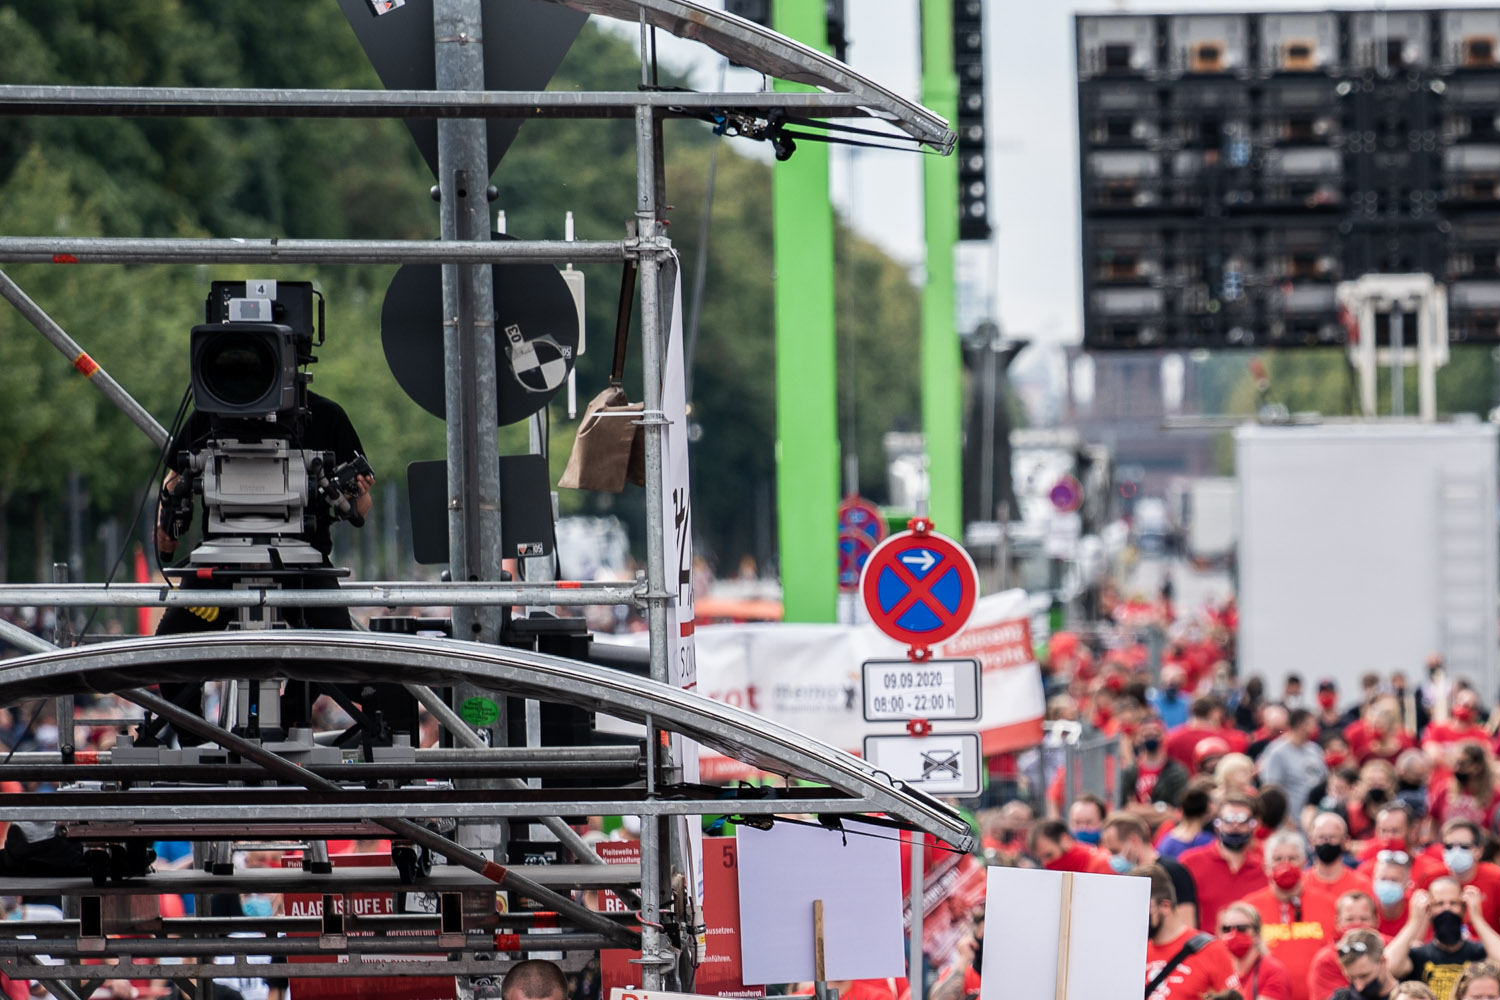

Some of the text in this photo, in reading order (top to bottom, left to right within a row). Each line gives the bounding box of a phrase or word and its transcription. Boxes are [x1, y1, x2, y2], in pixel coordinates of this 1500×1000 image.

[257, 284, 265, 295] 4
[884, 671, 943, 689] 09.09.2020
[874, 695, 904, 712] 08:00
[914, 694, 944, 711] 22:00
[947, 692, 955, 709] h
